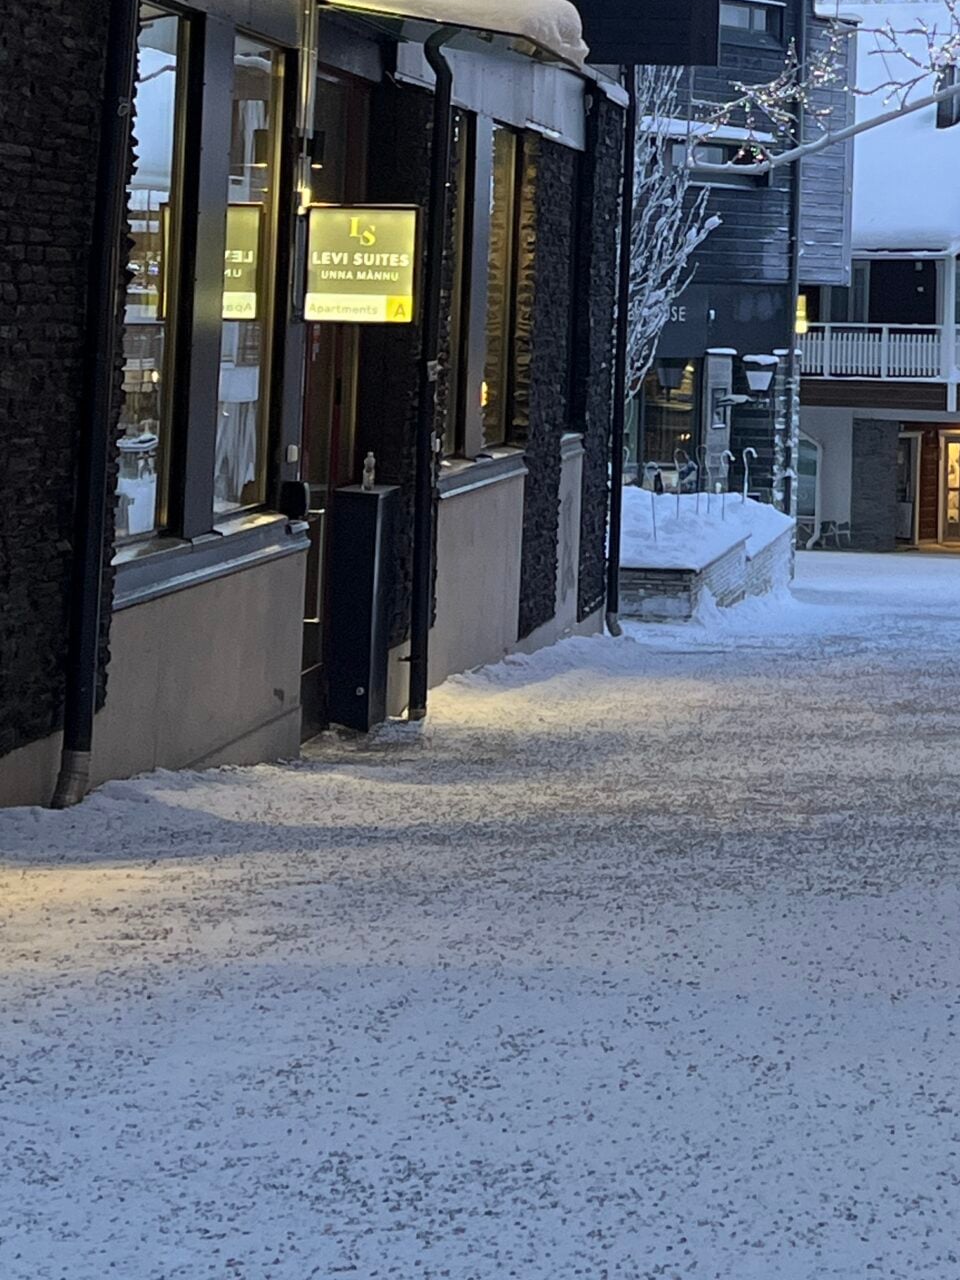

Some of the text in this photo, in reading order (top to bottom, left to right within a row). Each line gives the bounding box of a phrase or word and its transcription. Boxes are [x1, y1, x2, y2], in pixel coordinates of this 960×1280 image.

[311, 251, 410, 267] LEVI SUITES
[321, 269, 353, 280] UNNA
[309, 303, 406, 318] Apartments A
